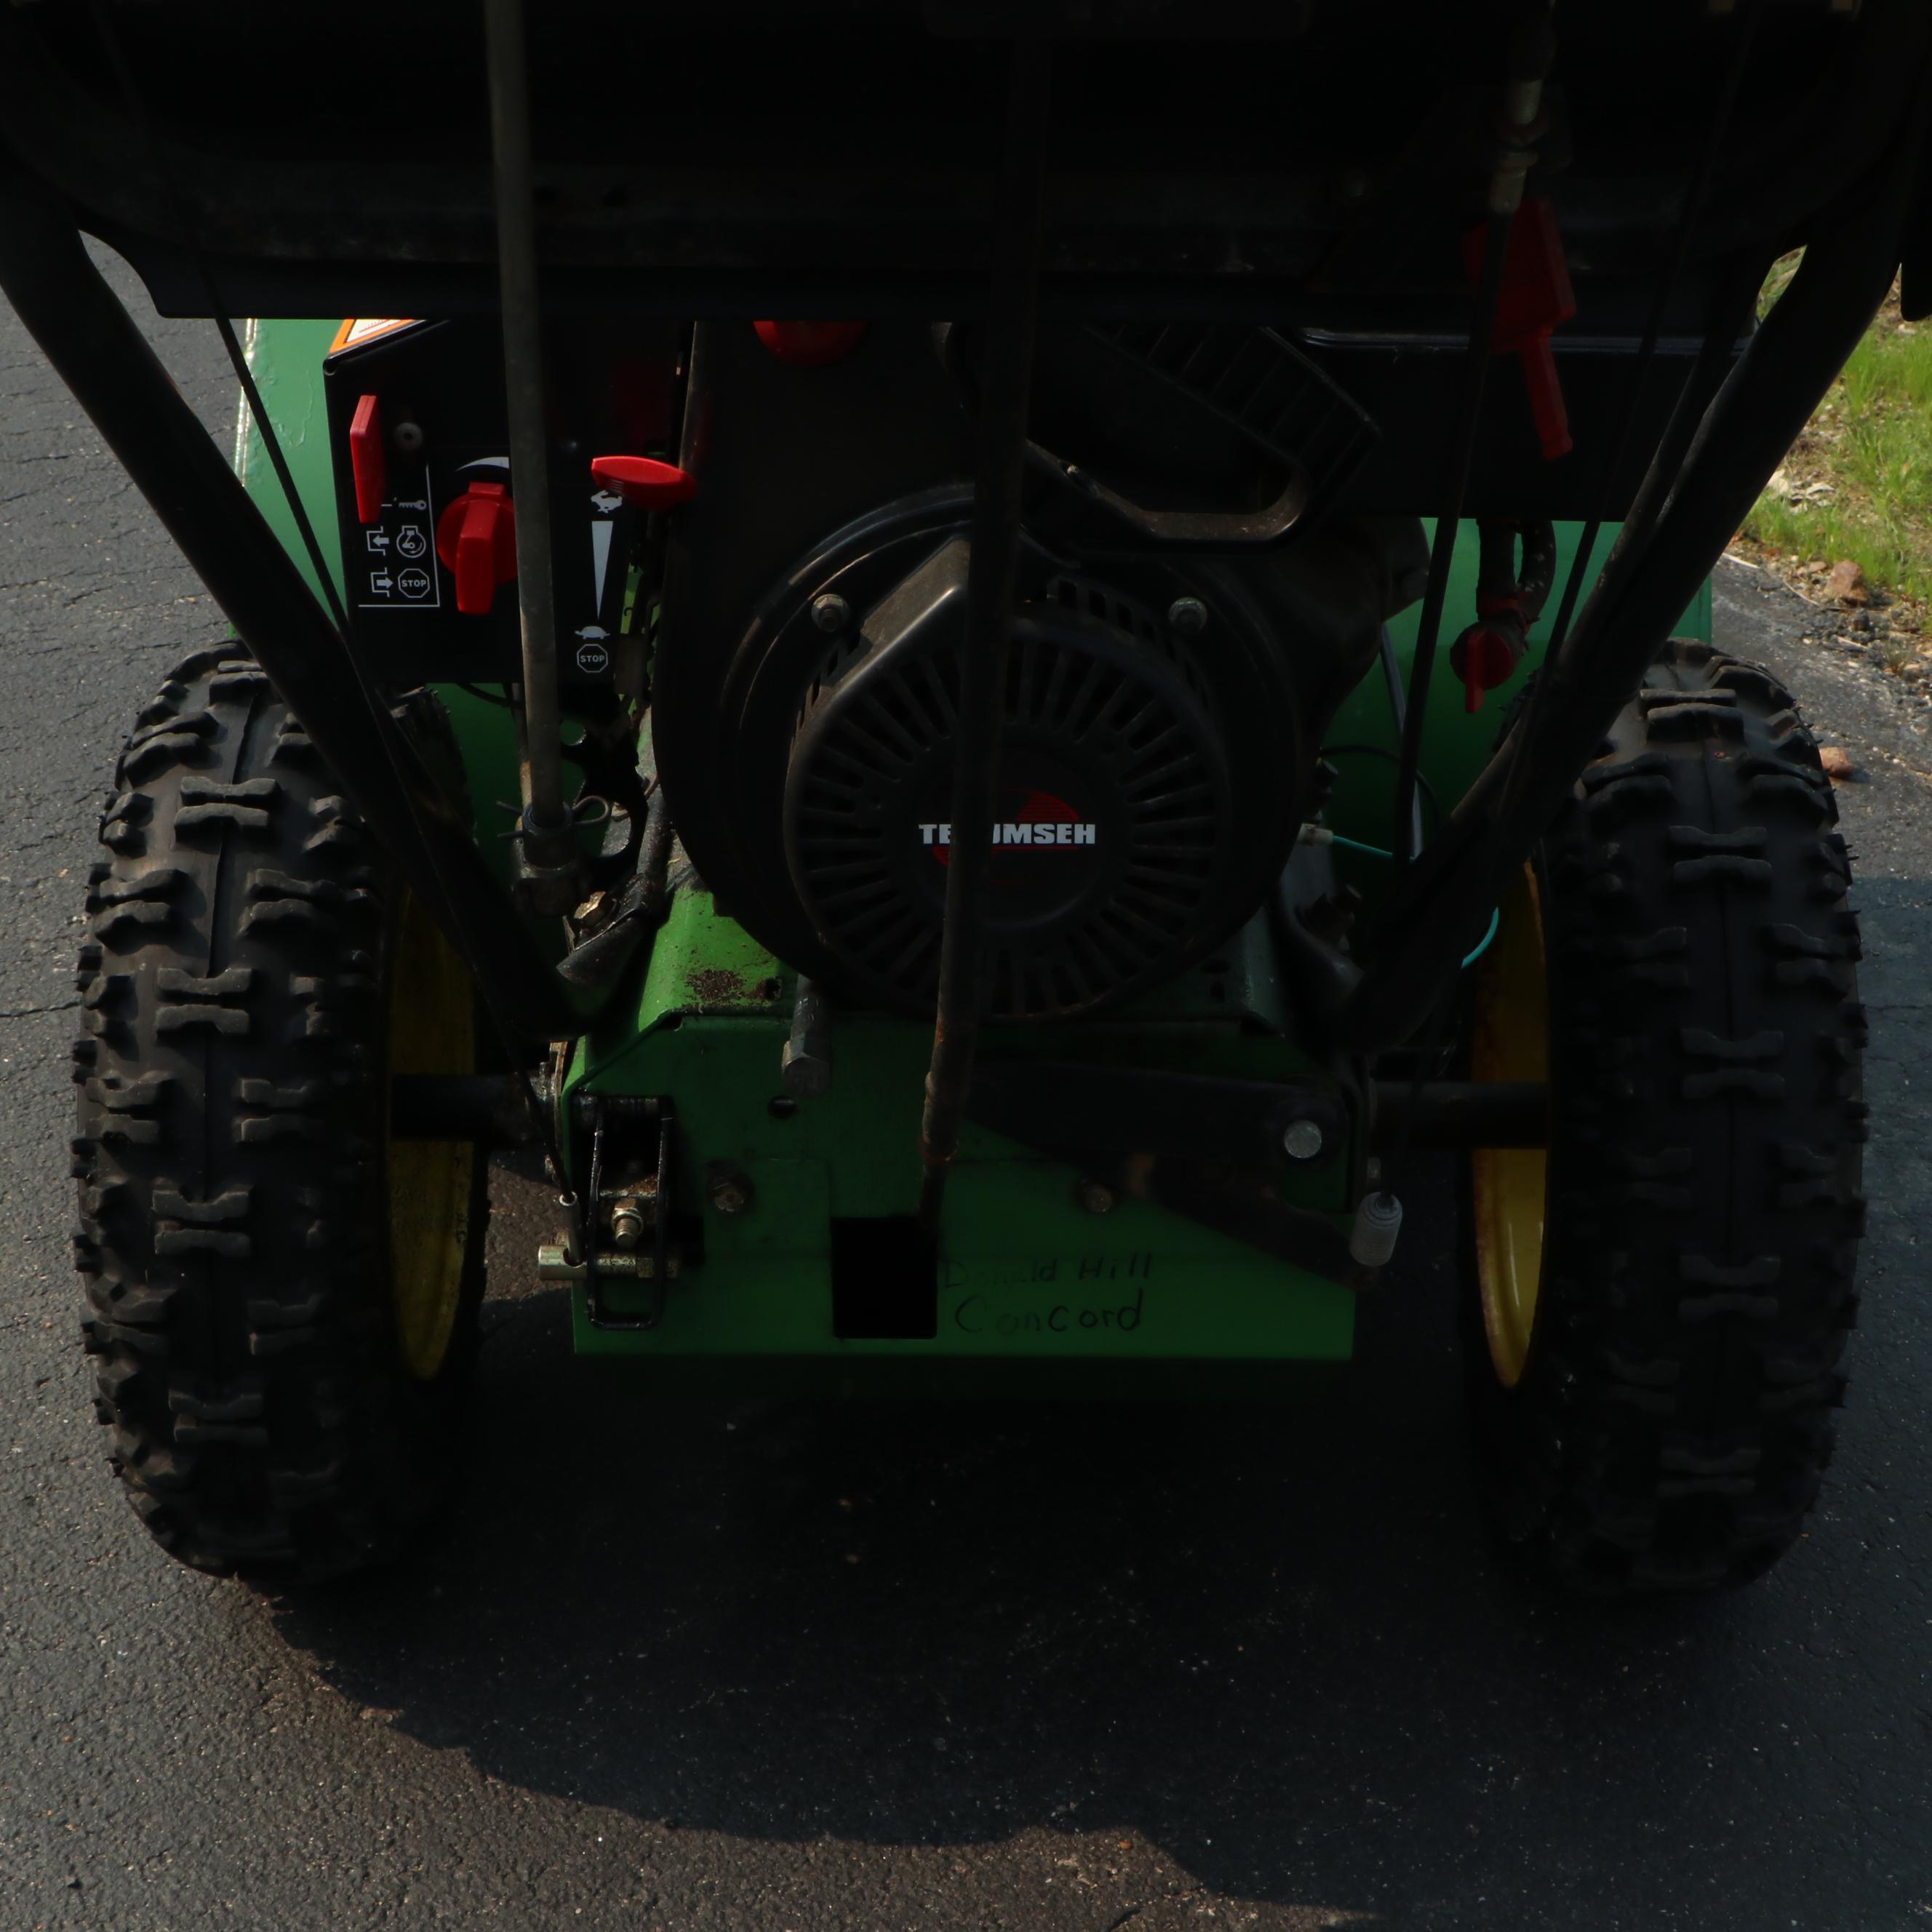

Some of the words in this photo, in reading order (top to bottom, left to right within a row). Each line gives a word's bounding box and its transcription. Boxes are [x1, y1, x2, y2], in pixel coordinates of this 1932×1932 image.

[401, 579, 427, 588] STOP
[580, 655, 605, 663] STOP
[919, 823, 1096, 845] TEMSEH
[1078, 1251, 1152, 1280] Hill
[954, 1288, 1143, 1334] Concord
